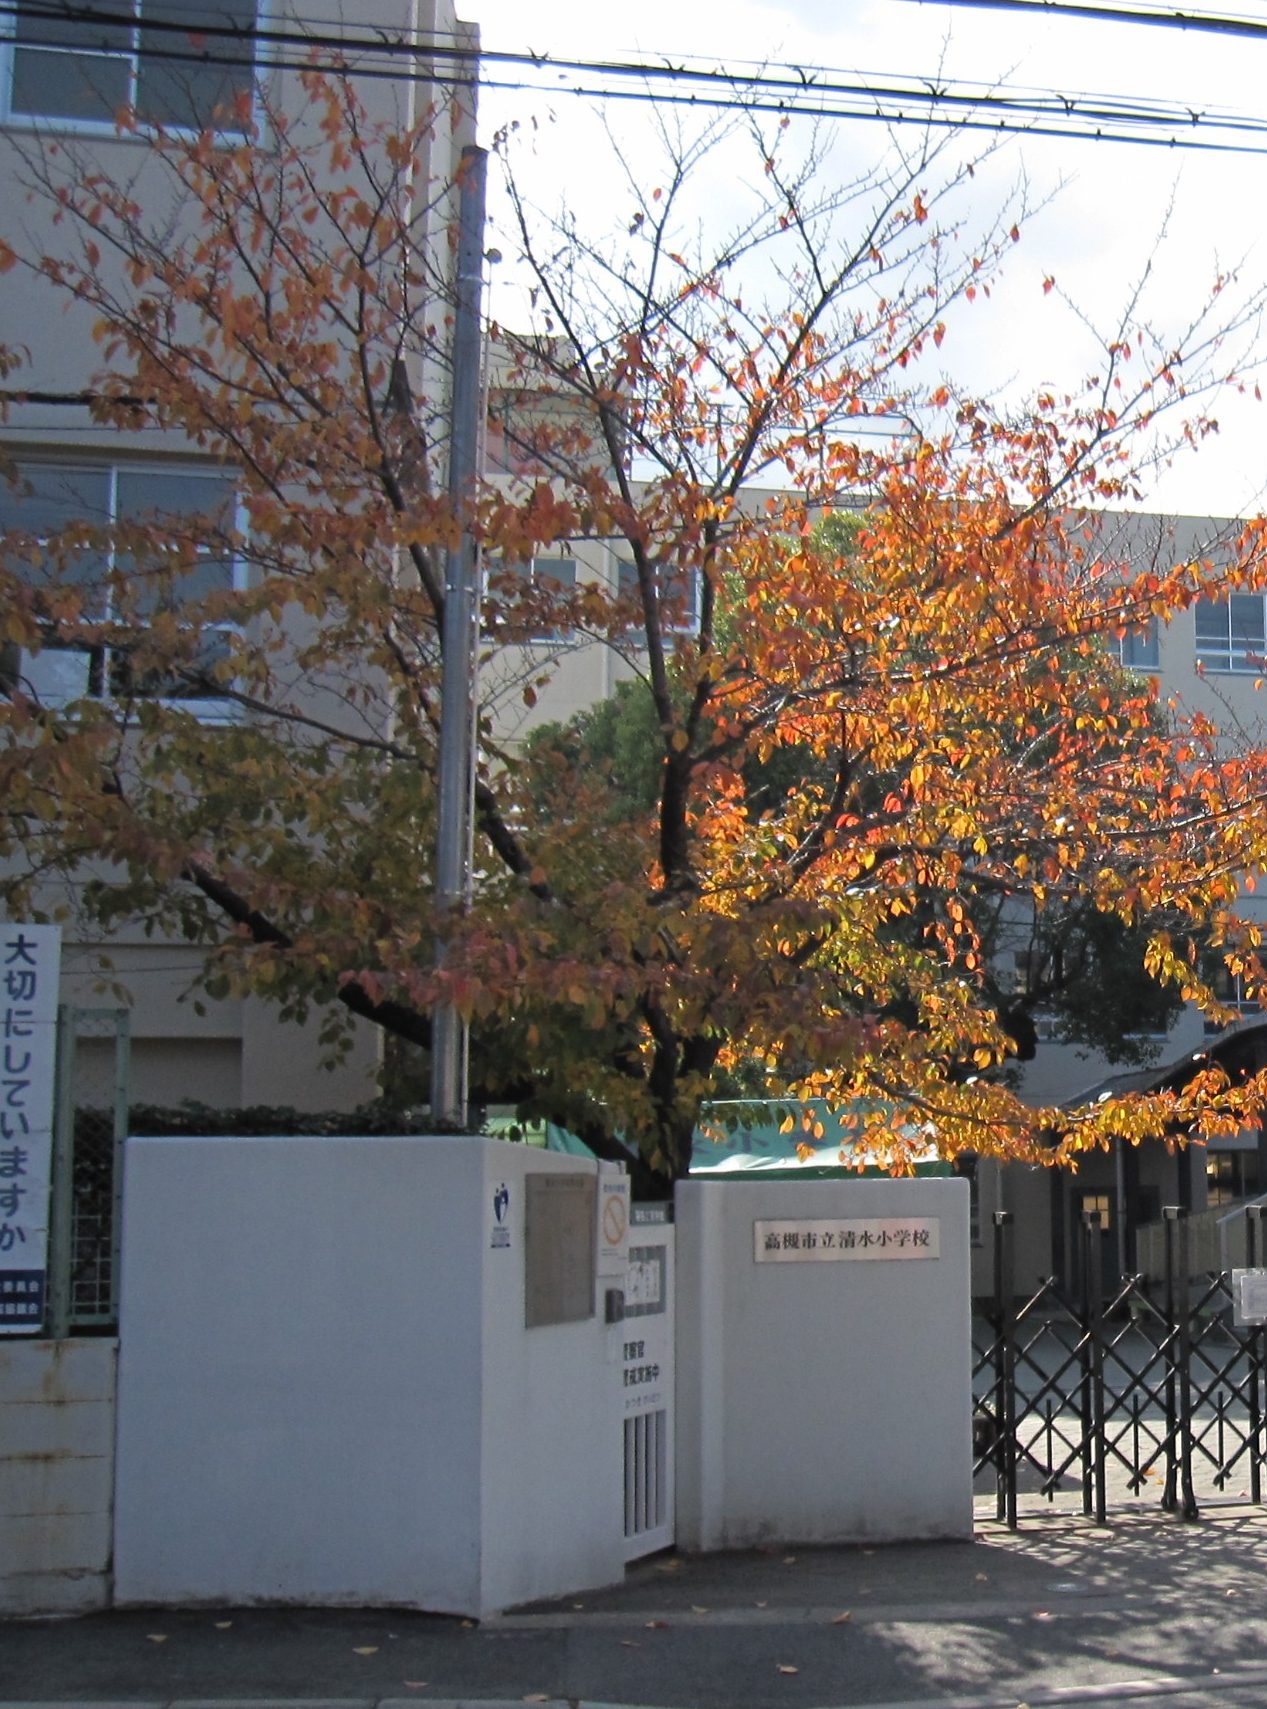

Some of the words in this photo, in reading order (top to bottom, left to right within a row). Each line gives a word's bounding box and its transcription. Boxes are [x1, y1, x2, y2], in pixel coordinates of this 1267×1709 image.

[0, 933, 37, 1252] 大切にしていますか
[764, 1229, 931, 1250] 高槻市立清水小学校
[0, 1280, 39, 1293] 委員会
